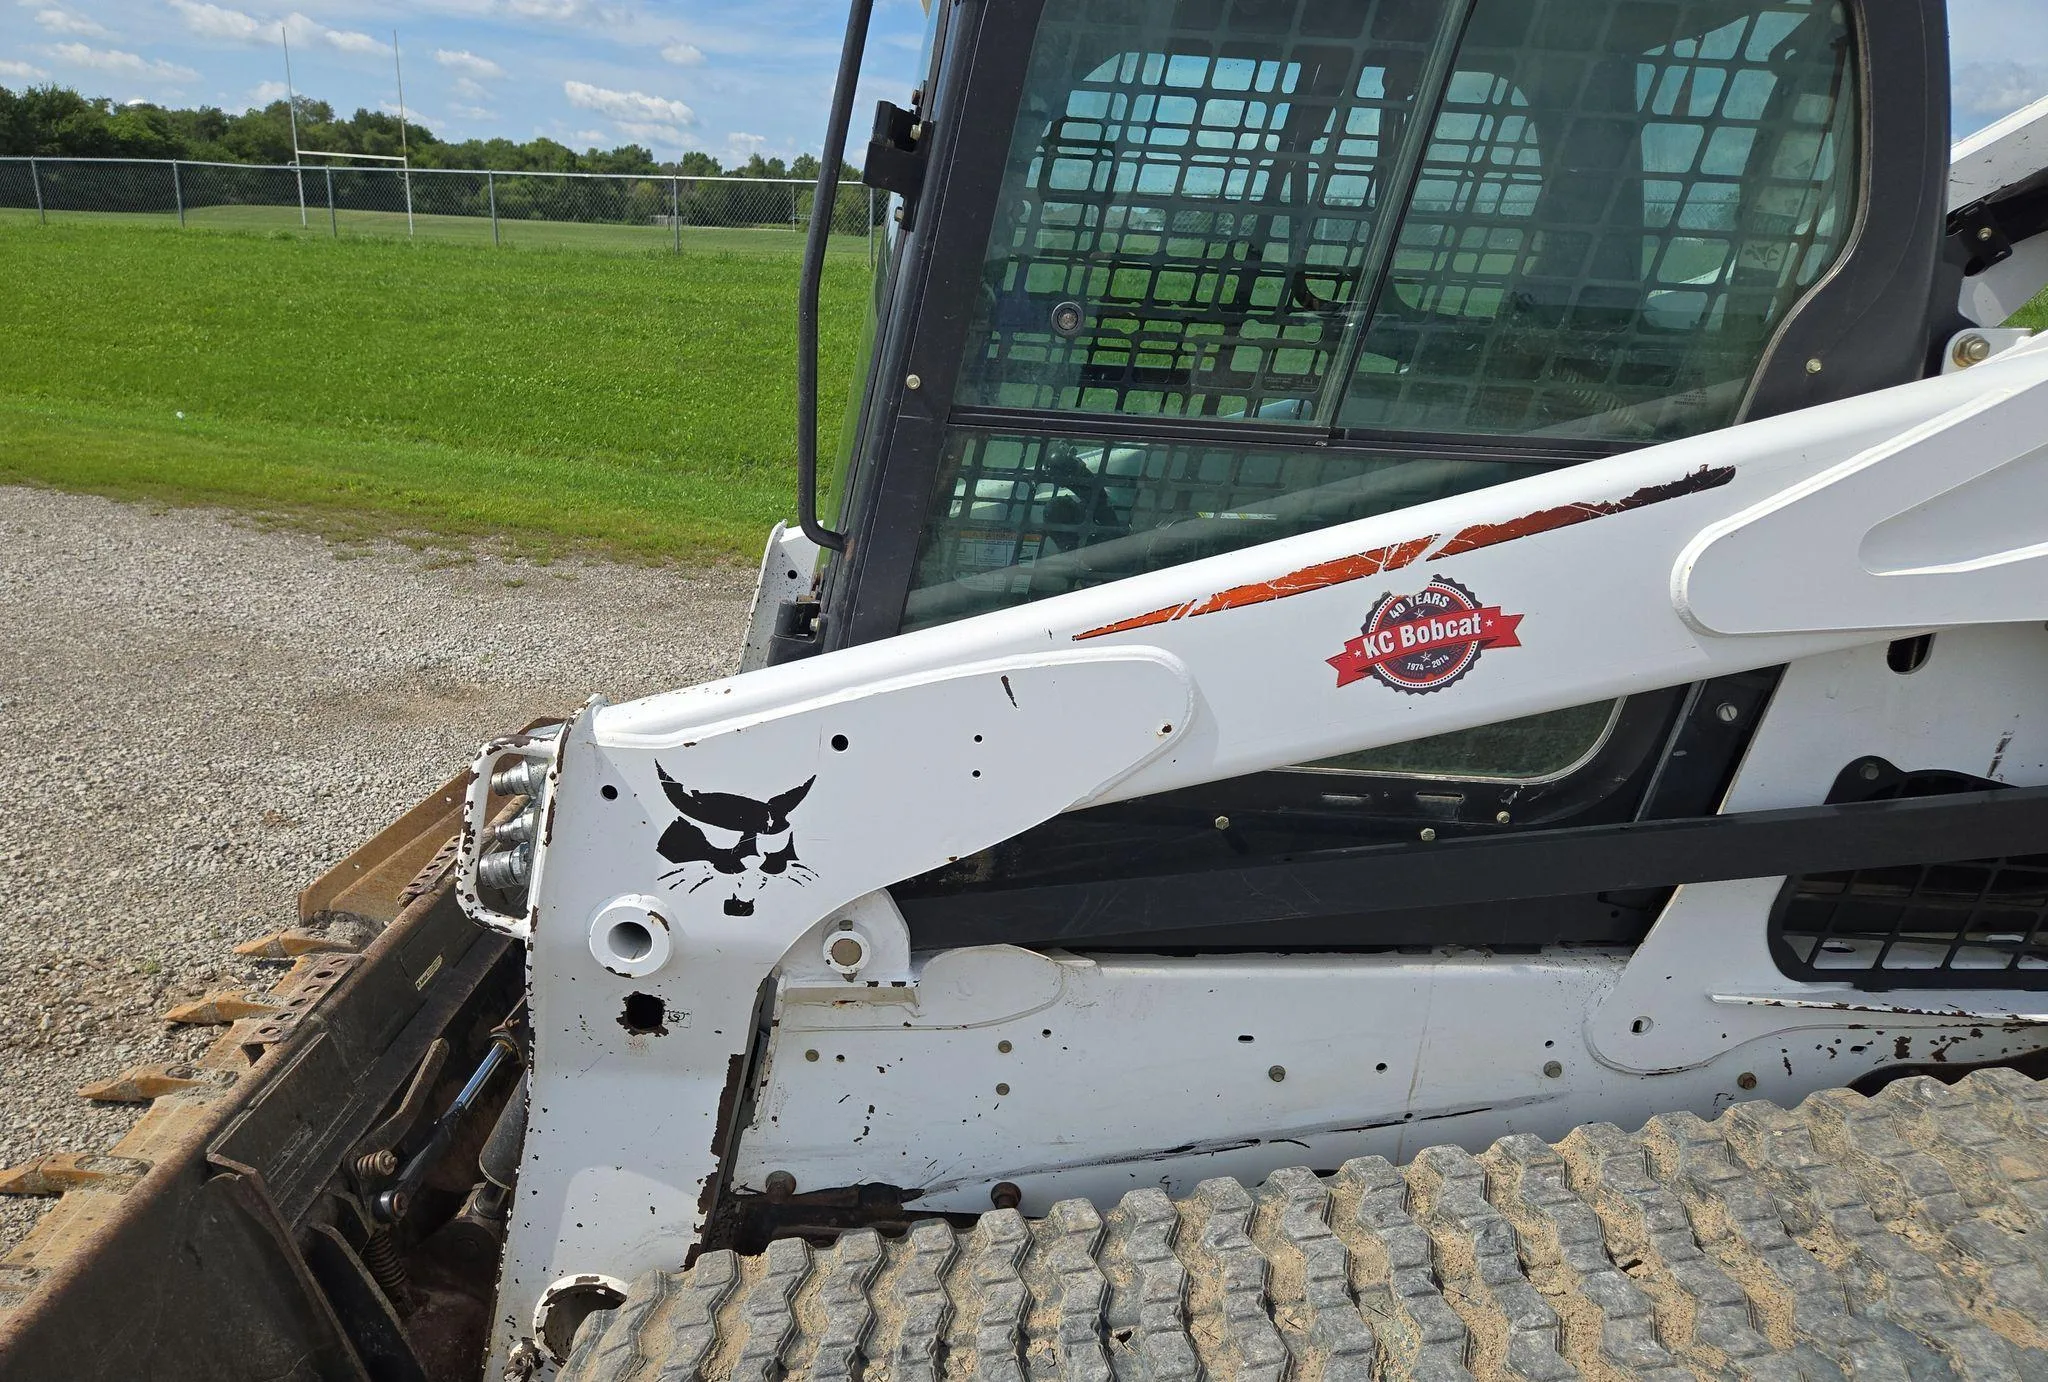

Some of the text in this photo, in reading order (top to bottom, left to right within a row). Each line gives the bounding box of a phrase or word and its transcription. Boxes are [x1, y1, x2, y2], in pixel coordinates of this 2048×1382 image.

[1389, 592, 1450, 619] 40 YEARS
[1362, 612, 1482, 659] KC Bobcat
[1407, 662, 1425, 671] 1974
[1432, 655, 1450, 669] 2014
